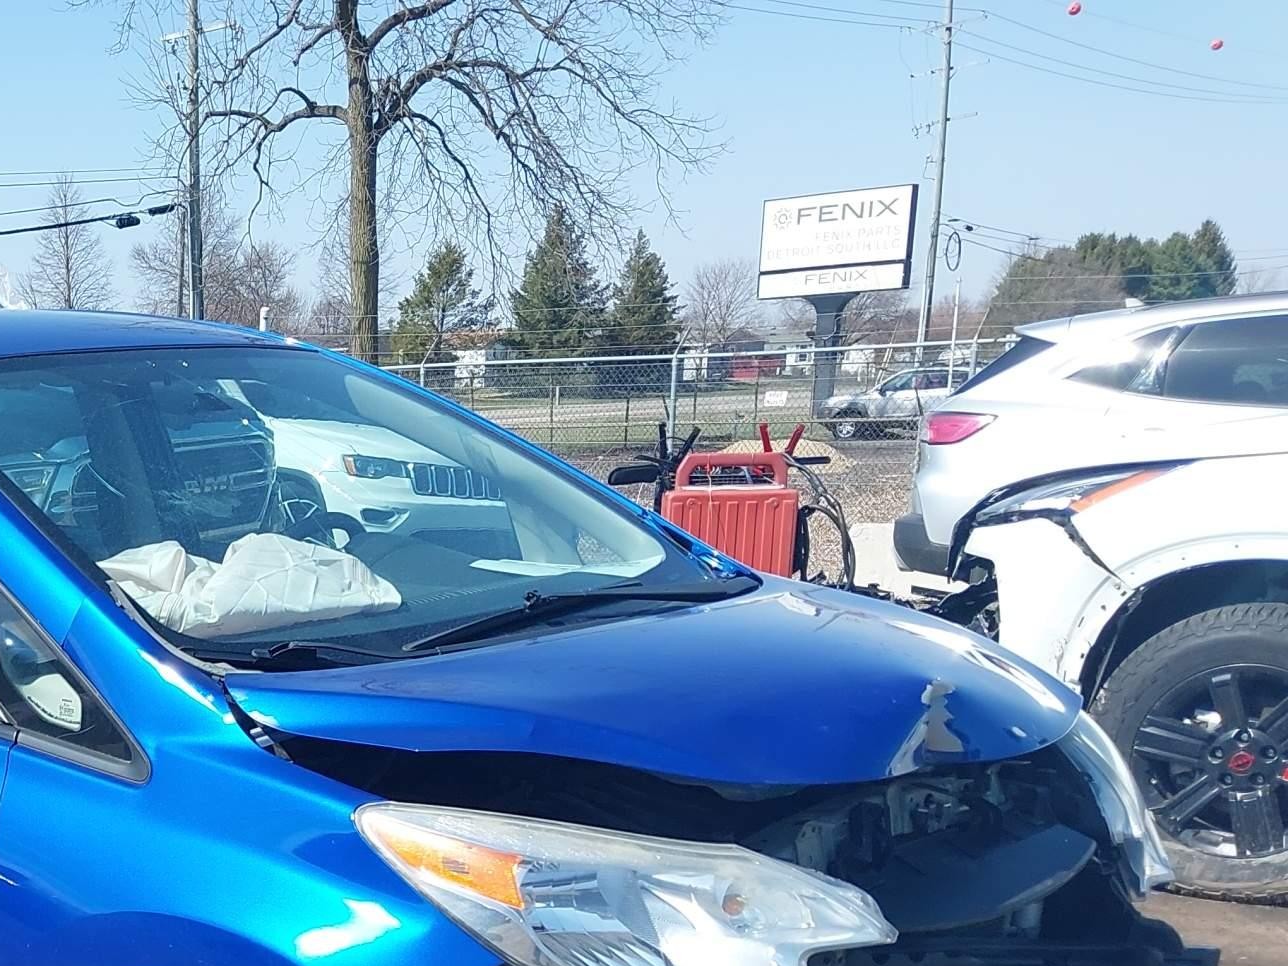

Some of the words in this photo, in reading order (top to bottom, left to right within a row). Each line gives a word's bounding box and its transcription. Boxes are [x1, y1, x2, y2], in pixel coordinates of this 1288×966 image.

[797, 198, 899, 225] FENIX
[815, 230, 852, 242] FENIX
[857, 225, 902, 239] PARTS
[767, 246, 821, 261] DETROIT
[828, 242, 872, 256] SOUTH
[874, 238, 901, 250] LLC
[804, 269, 869, 286] FENIX
